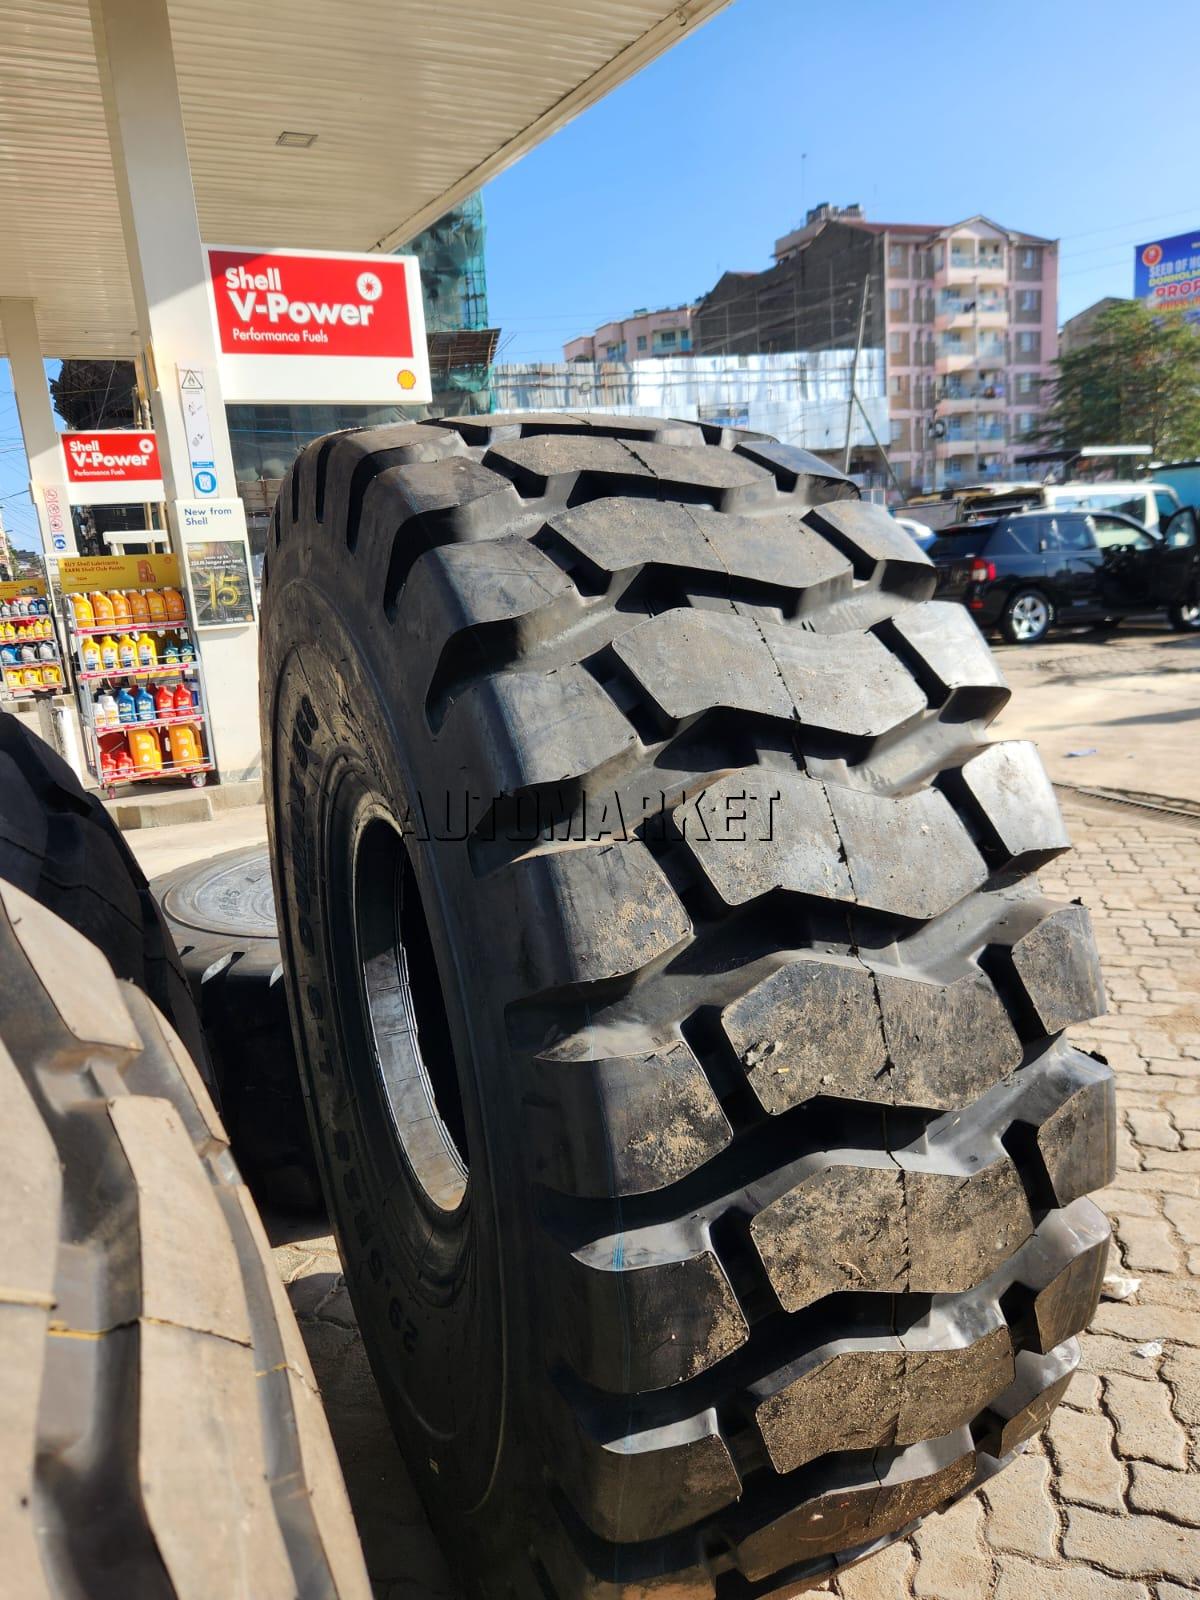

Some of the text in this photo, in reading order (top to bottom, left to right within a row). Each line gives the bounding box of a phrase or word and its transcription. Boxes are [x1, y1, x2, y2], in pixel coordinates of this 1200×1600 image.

[225, 267, 281, 291] Shell
[227, 292, 374, 325] V-Power
[232, 327, 329, 343] Performance Fuels
[69, 440, 99, 452] Shell
[72, 453, 150, 466] V-Power
[74, 469, 110, 477] Performance
[185, 507, 232, 517] New from
[186, 517, 208, 526] Shell
